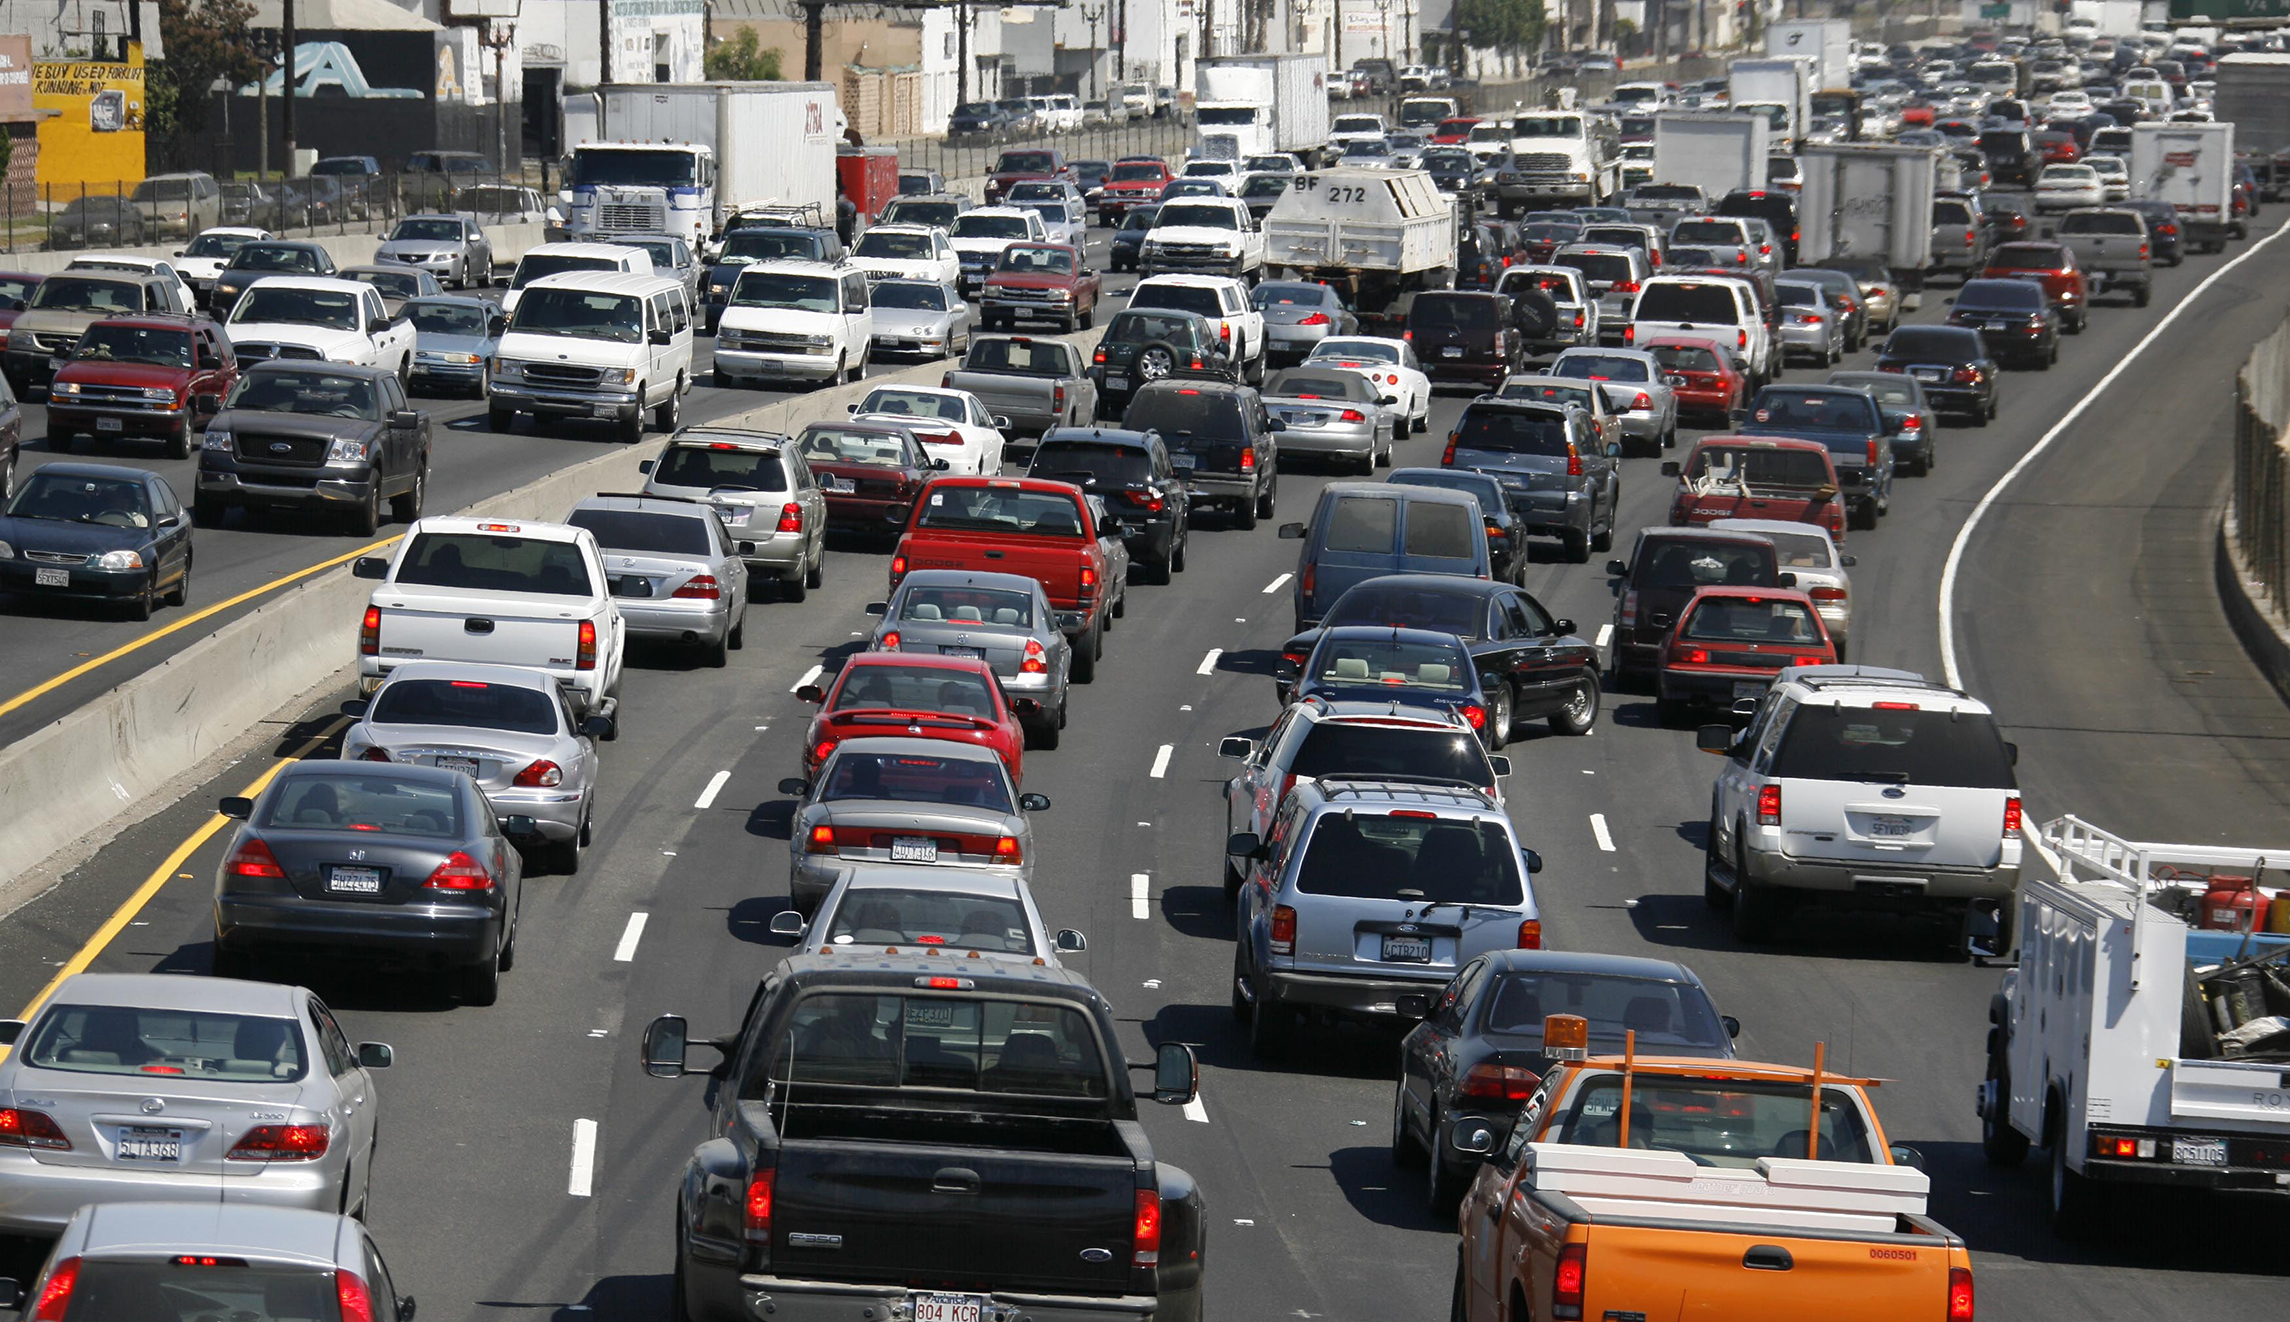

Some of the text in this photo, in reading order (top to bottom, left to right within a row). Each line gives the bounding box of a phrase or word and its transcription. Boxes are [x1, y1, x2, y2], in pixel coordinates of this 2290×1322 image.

[44, 65, 70, 79] BUY
[73, 65, 105, 79] USED
[106, 67, 144, 80] FORKLIFT
[35, 80, 83, 95] RUNNING
[88, 82, 106, 95] NOT
[1294, 176, 1365, 203] BF 272
[1385, 944, 1428, 959] 4CTB210
[121, 1139, 177, 1157] 5LTA368
[790, 1234, 841, 1244] F-350
[1870, 1249, 1917, 1260] 0060501
[917, 1304, 978, 1322] 804 KCR
